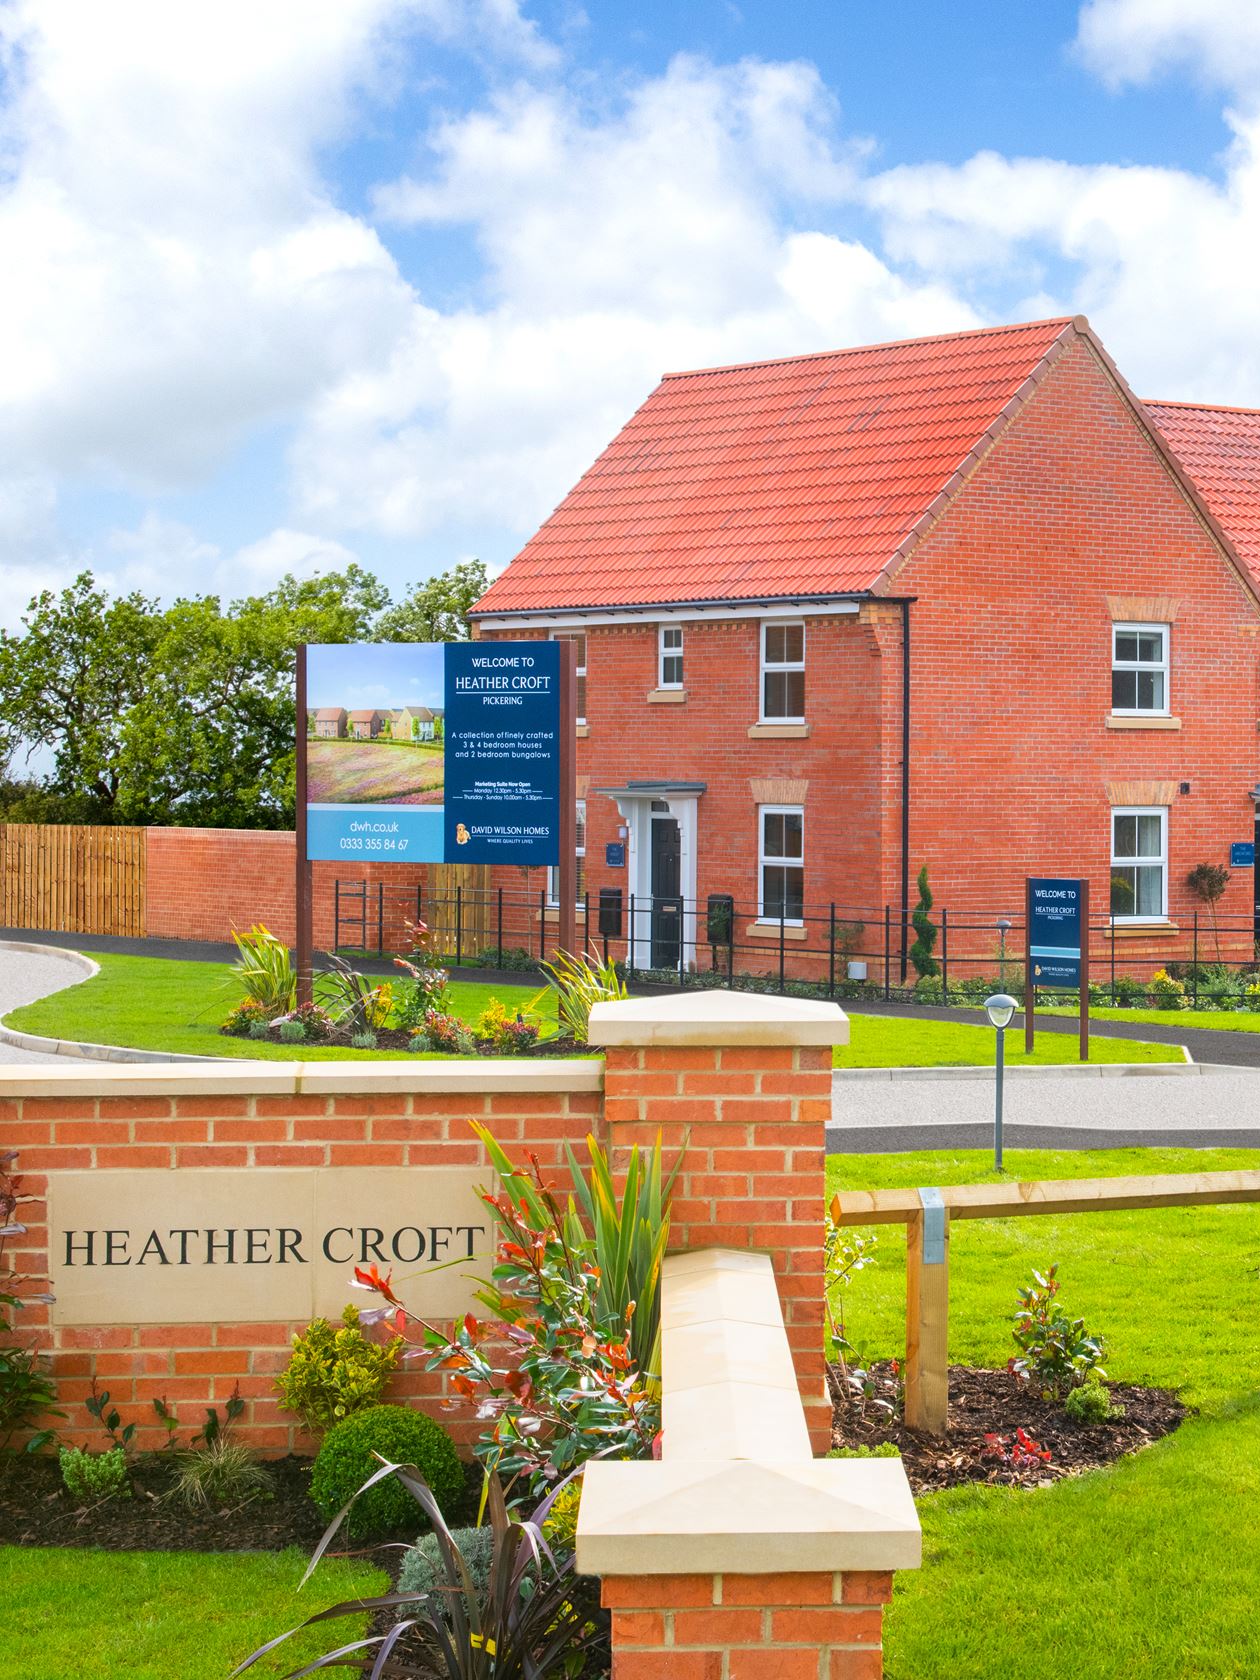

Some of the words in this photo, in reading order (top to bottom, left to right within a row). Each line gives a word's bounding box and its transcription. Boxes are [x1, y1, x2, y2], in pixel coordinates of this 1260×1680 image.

[472, 658, 519, 667] WELCOME
[521, 658, 534, 667] TO
[456, 677, 508, 689] HEATHER
[512, 677, 550, 688] CROFT
[483, 696, 522, 705] PICKERING
[350, 821, 399, 832] dwh.co.uk
[340, 838, 363, 849] 0333
[365, 838, 381, 849] 355
[384, 839, 395, 850] 84
[398, 840, 408, 850] 67
[1035, 890, 1066, 898] WELCOME
[62, 1227, 309, 1266] HEATHER
[322, 1226, 486, 1263] CROFT
